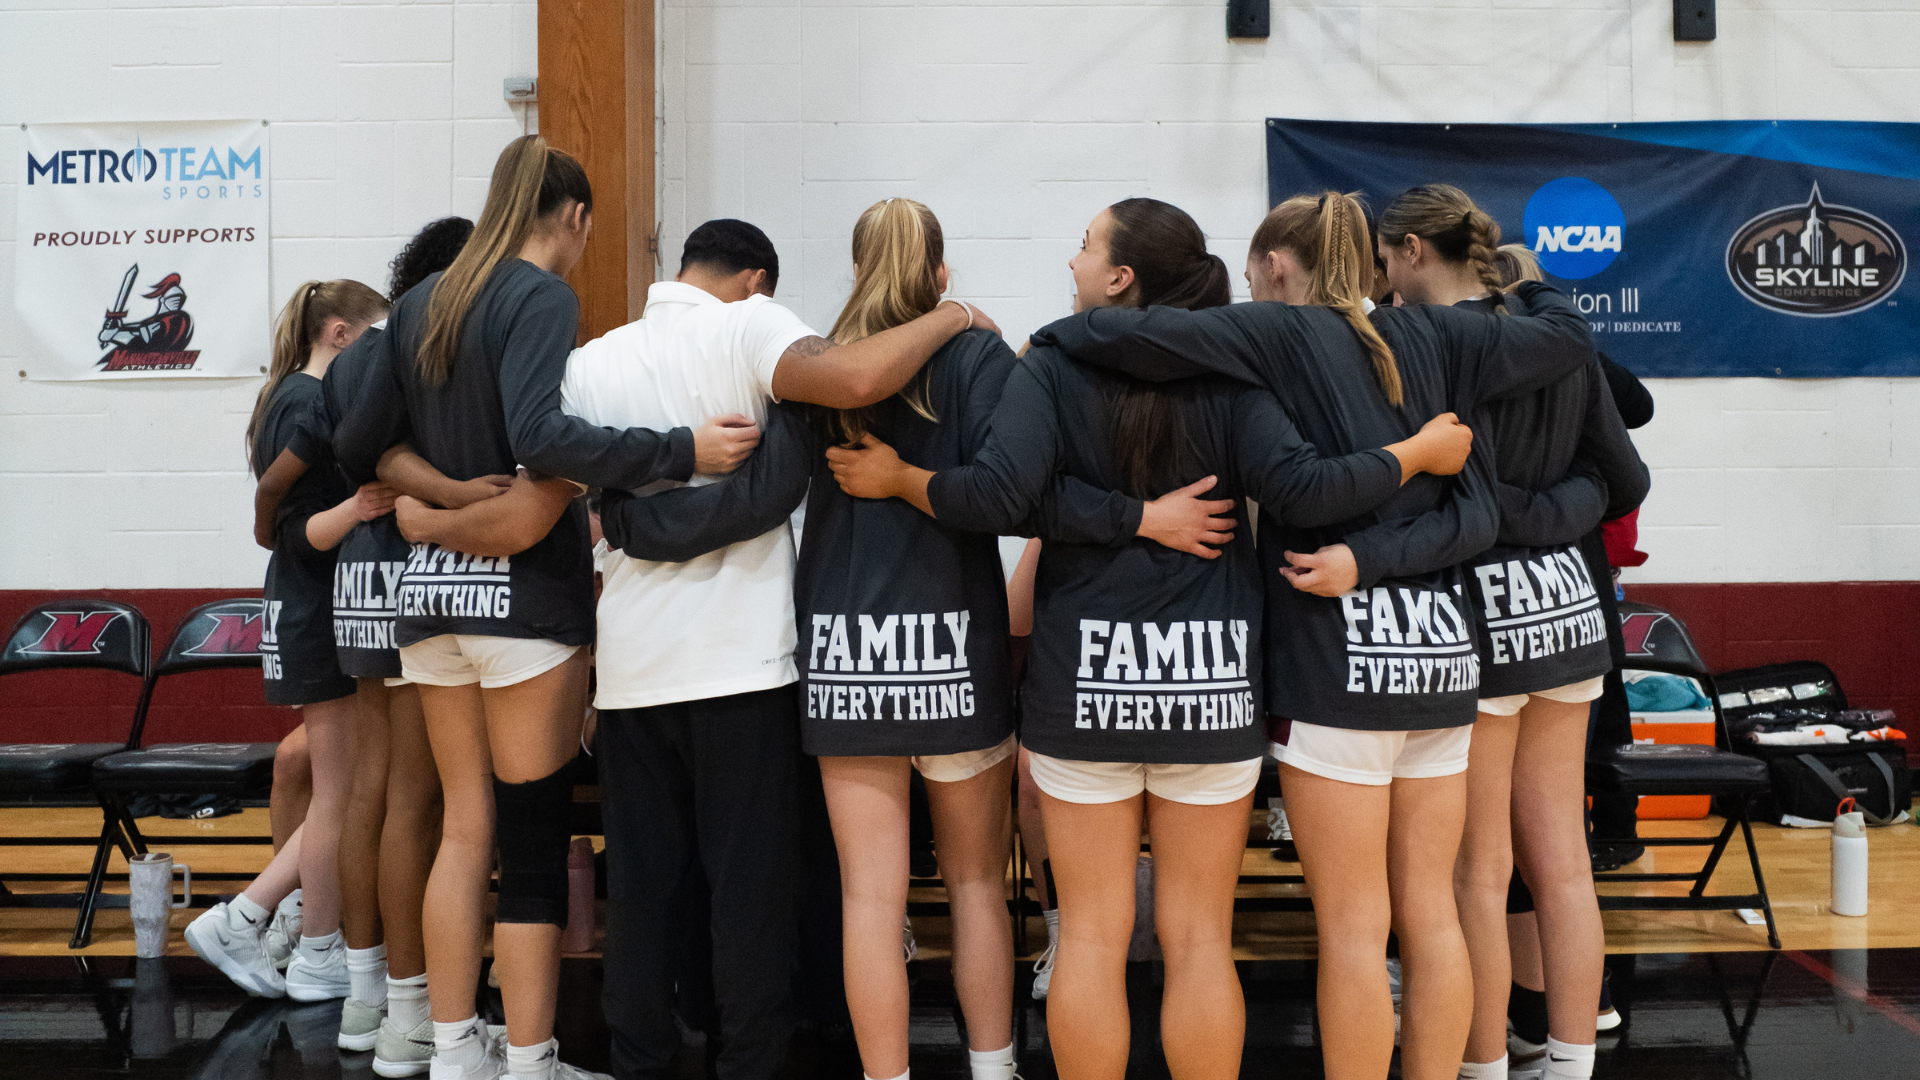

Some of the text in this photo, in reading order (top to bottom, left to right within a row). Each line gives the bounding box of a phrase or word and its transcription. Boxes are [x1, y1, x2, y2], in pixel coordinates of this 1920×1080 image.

[162, 184, 262, 200] SPORTS
[33, 226, 256, 247] PROUDLY SUPPORTS
[1535, 225, 1622, 252] NCAA
[1755, 267, 1880, 287] SKYLINE
[1774, 287, 1862, 297] CONFERENCE
[1613, 321, 1682, 332] DEDICATE
[121, 363, 192, 371] ATHLETICS
[808, 610, 971, 672] FAMILY
[1490, 607, 1607, 665] EVERYTHIN
[1076, 618, 1249, 681] FAMILY
[807, 681, 976, 721] EVERYTHING
[1075, 690, 1255, 731] EVERYTHING
